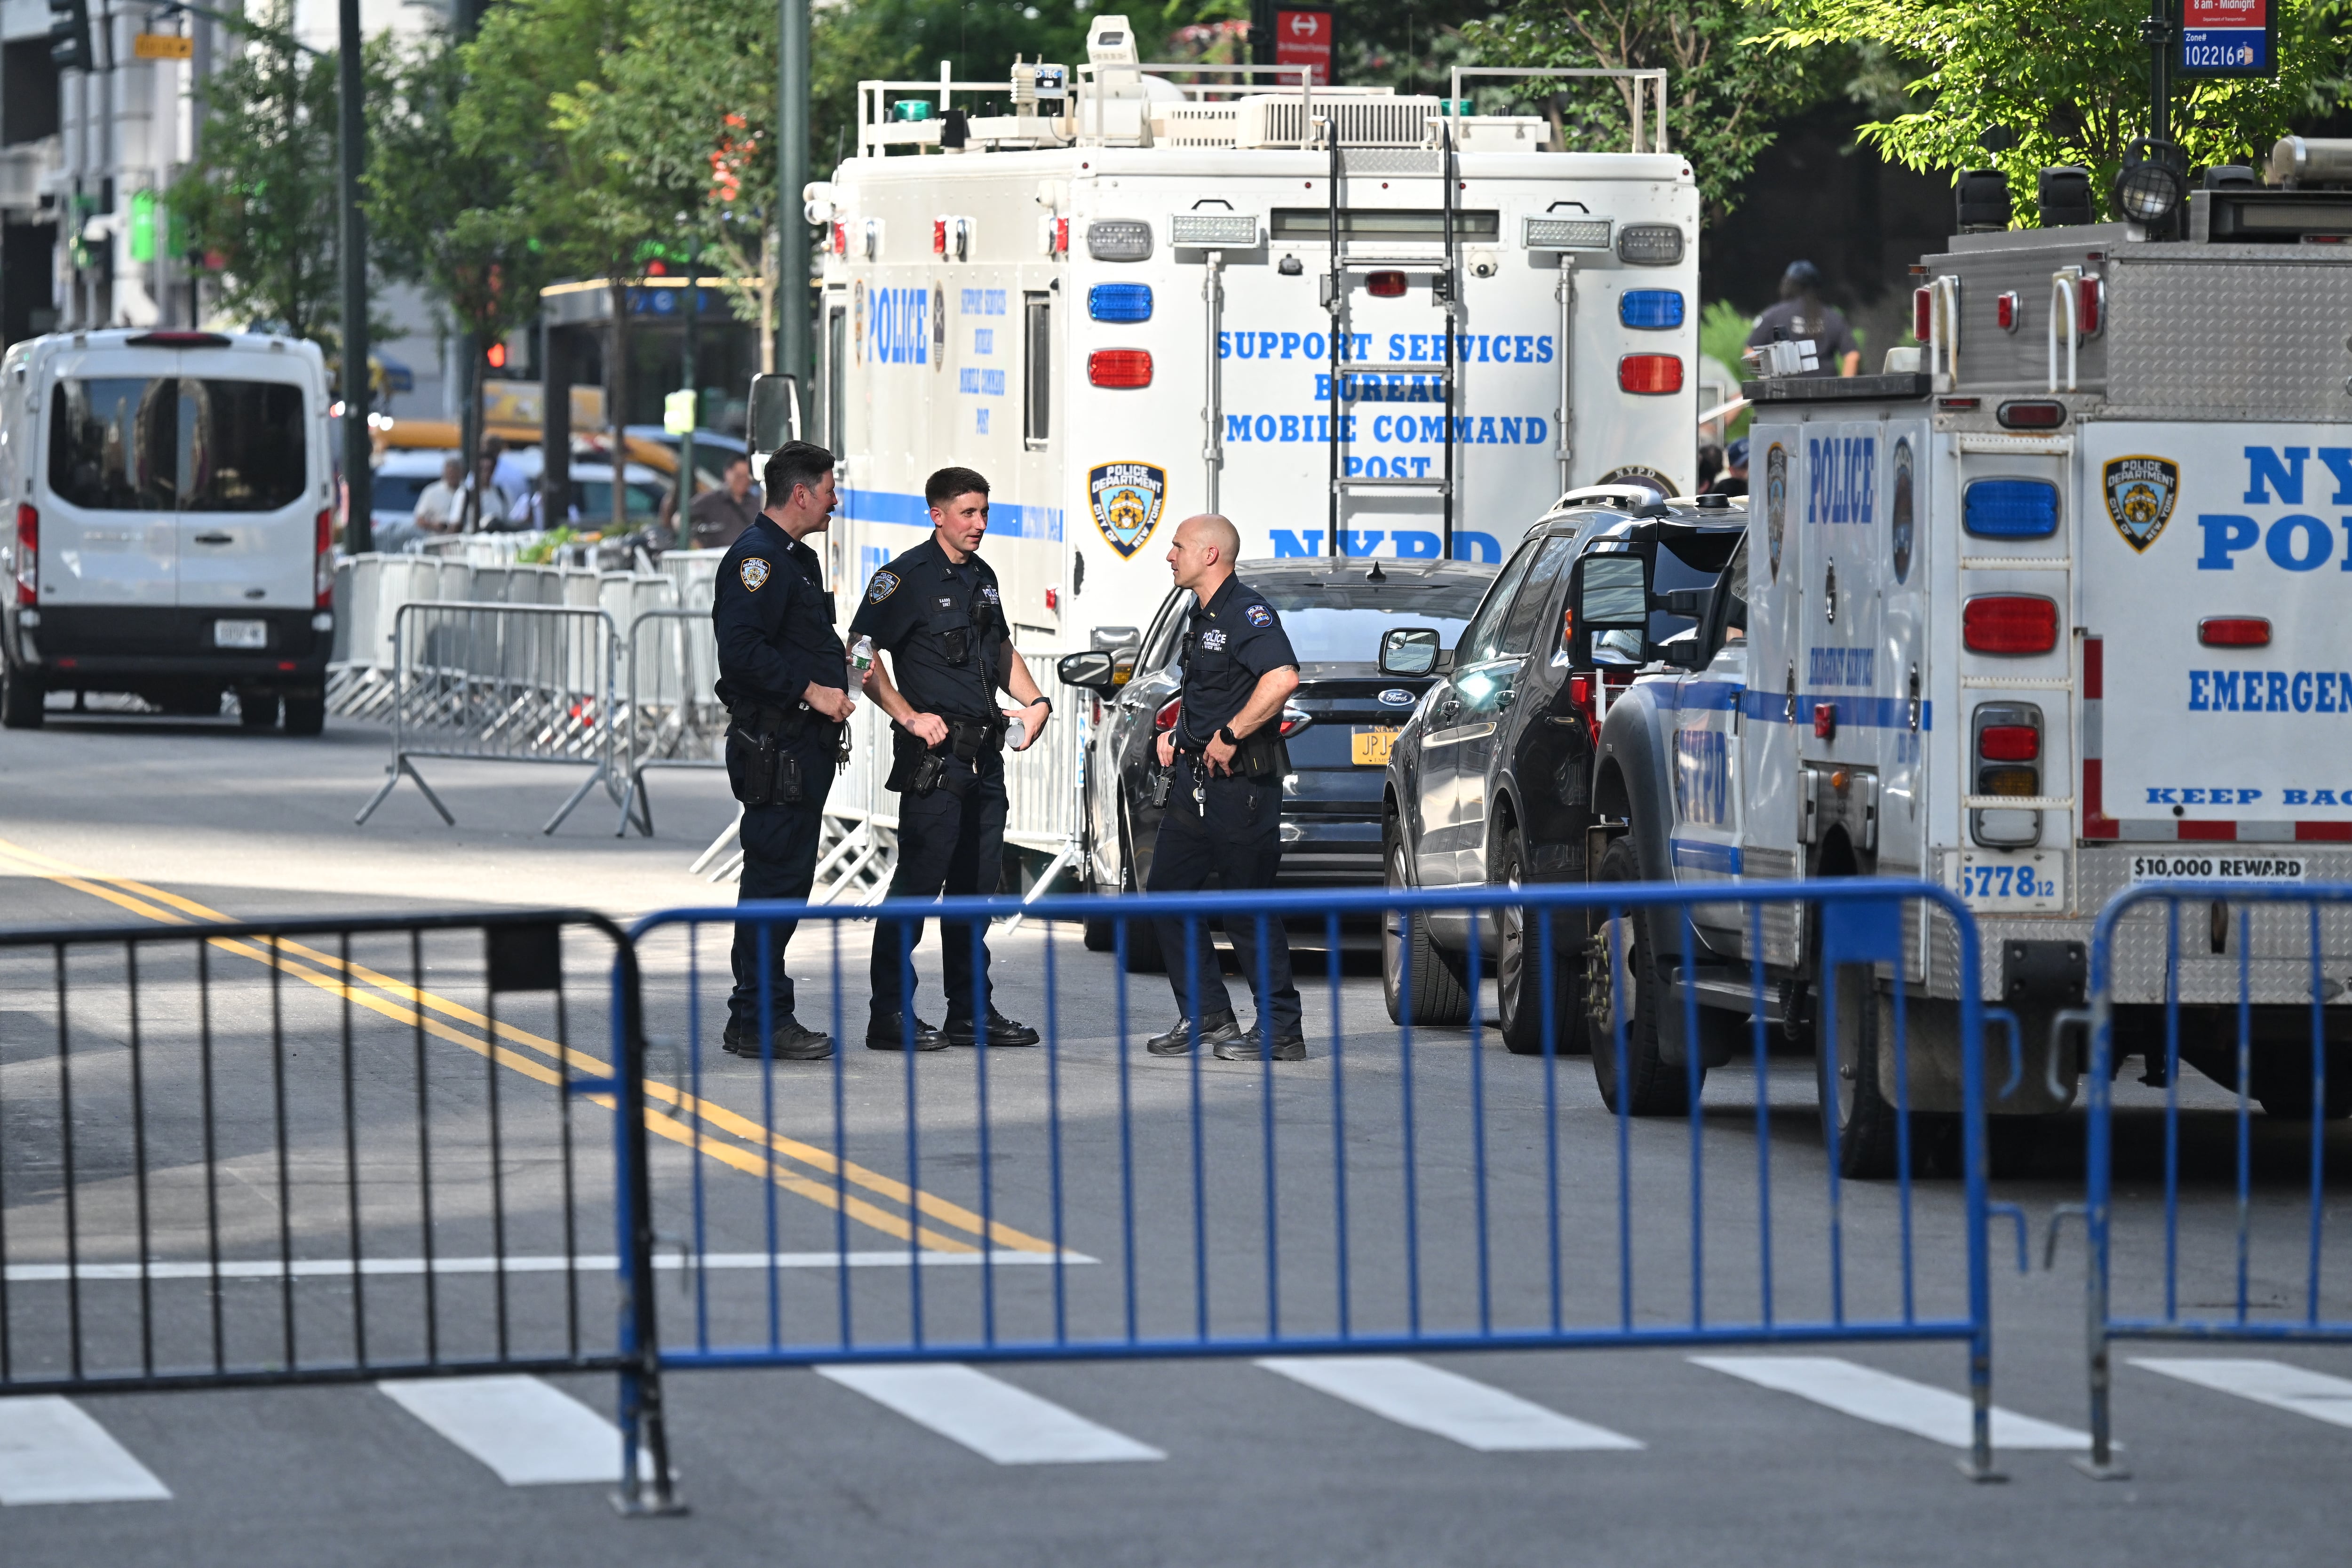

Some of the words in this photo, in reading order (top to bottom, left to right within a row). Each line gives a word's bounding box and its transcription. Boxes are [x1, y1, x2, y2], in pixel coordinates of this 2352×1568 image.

[2194, 0, 2199, 9] 8
[2201, 0, 2213, 9] am
[2220, 0, 2255, 12] Midnight
[2185, 33, 2207, 42] Zone#
[2185, 46, 2235, 65] 102216
[868, 287, 927, 365] POLICE
[1217, 331, 1372, 360] SUPPORT
[1389, 333, 1553, 363] SERVICES
[1314, 374, 1446, 402] BUREAU
[1226, 414, 1357, 442] MOBILE
[1373, 414, 1548, 445] COMMAND
[1106, 464, 1149, 478] POLICE
[1343, 455, 1430, 478] POST
[1615, 467, 1656, 478] NYPD
[2122, 460, 2162, 473] POLICE
[1092, 475, 1162, 493] DEPARTMENT
[1809, 437, 1874, 525] POLICE
[2108, 470, 2175, 487] DEPARTMENT
[1093, 502, 1108, 527] CITY
[1104, 530, 1119, 542] OF
[1132, 526, 1150, 548] NEW
[1147, 498, 1162, 524] YORK
[2109, 497, 2123, 520] CITY
[2120, 524, 2133, 536] OF
[2145, 521, 2162, 541] NEW
[2161, 493, 2175, 518] YORK
[1269, 529, 1502, 564] NYPD
[2197, 514, 2352, 572] PO
[743, 562, 768, 571] DEPARTMENT
[874, 575, 896, 586] DEPARTMENT
[883, 587, 894, 596] YORK
[1248, 606, 1265, 616] POLICE
[1201, 632, 1227, 644] POLICE
[1386, 692, 1407, 702] Ford
[2146, 788, 2263, 805] KEEP
[2135, 857, 2213, 877] $10,000
[2220, 860, 2302, 877] REWARD
[1956, 866, 2036, 898] 5778
[2037, 881, 2055, 897] 12
